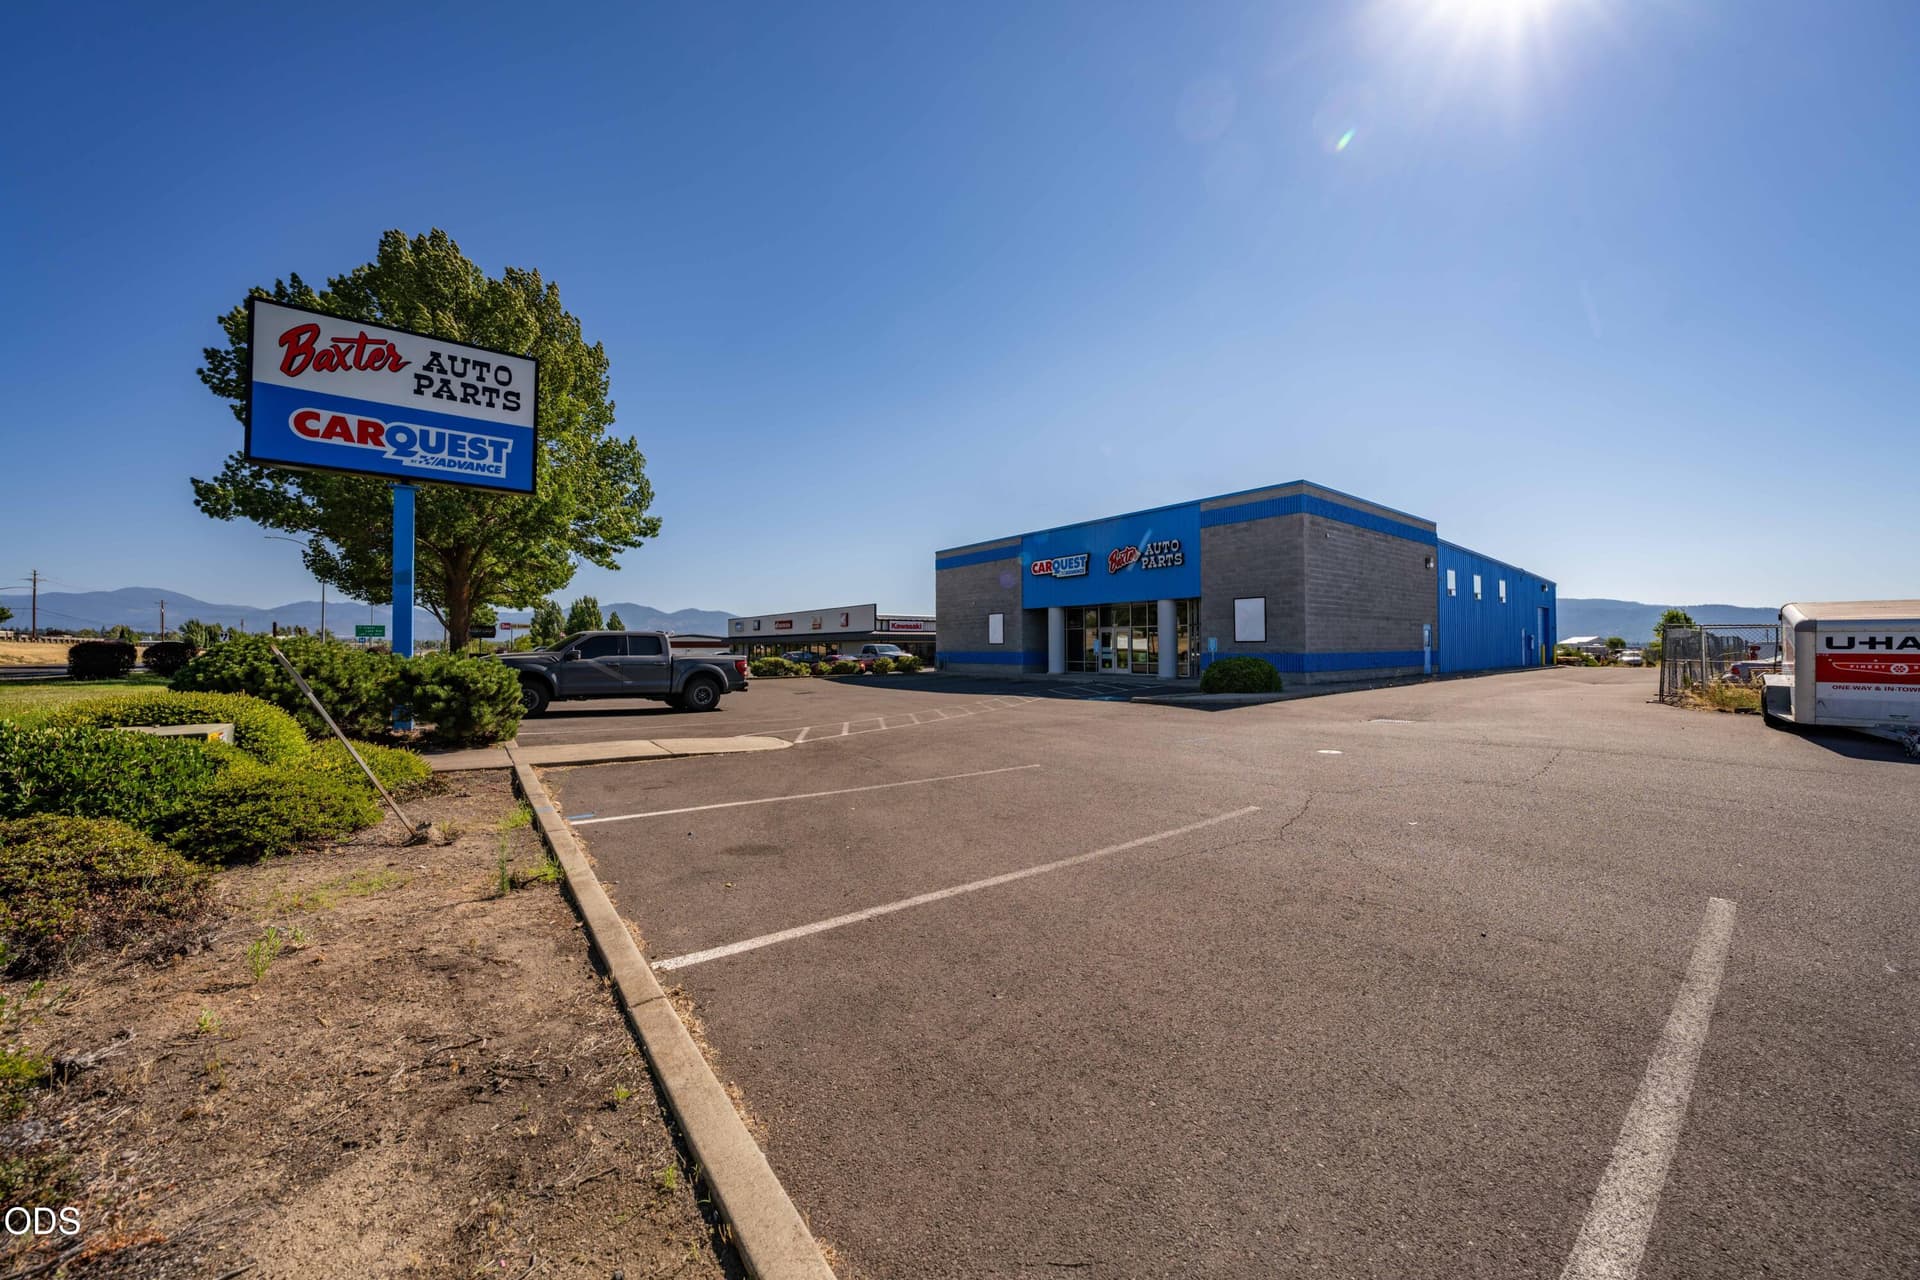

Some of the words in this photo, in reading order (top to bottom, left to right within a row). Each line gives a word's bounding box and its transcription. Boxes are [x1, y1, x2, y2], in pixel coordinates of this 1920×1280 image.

[279, 323, 411, 377] Baxter
[422, 351, 513, 387] AUTO
[413, 372, 521, 412] PARTS
[293, 410, 510, 463] CARQUEST
[434, 458, 502, 474] ADVANCE
[1141, 553, 1182, 569] PARTS
[1145, 540, 1179, 555] AUTO
[1032, 556, 1086, 574] CARQUEST
